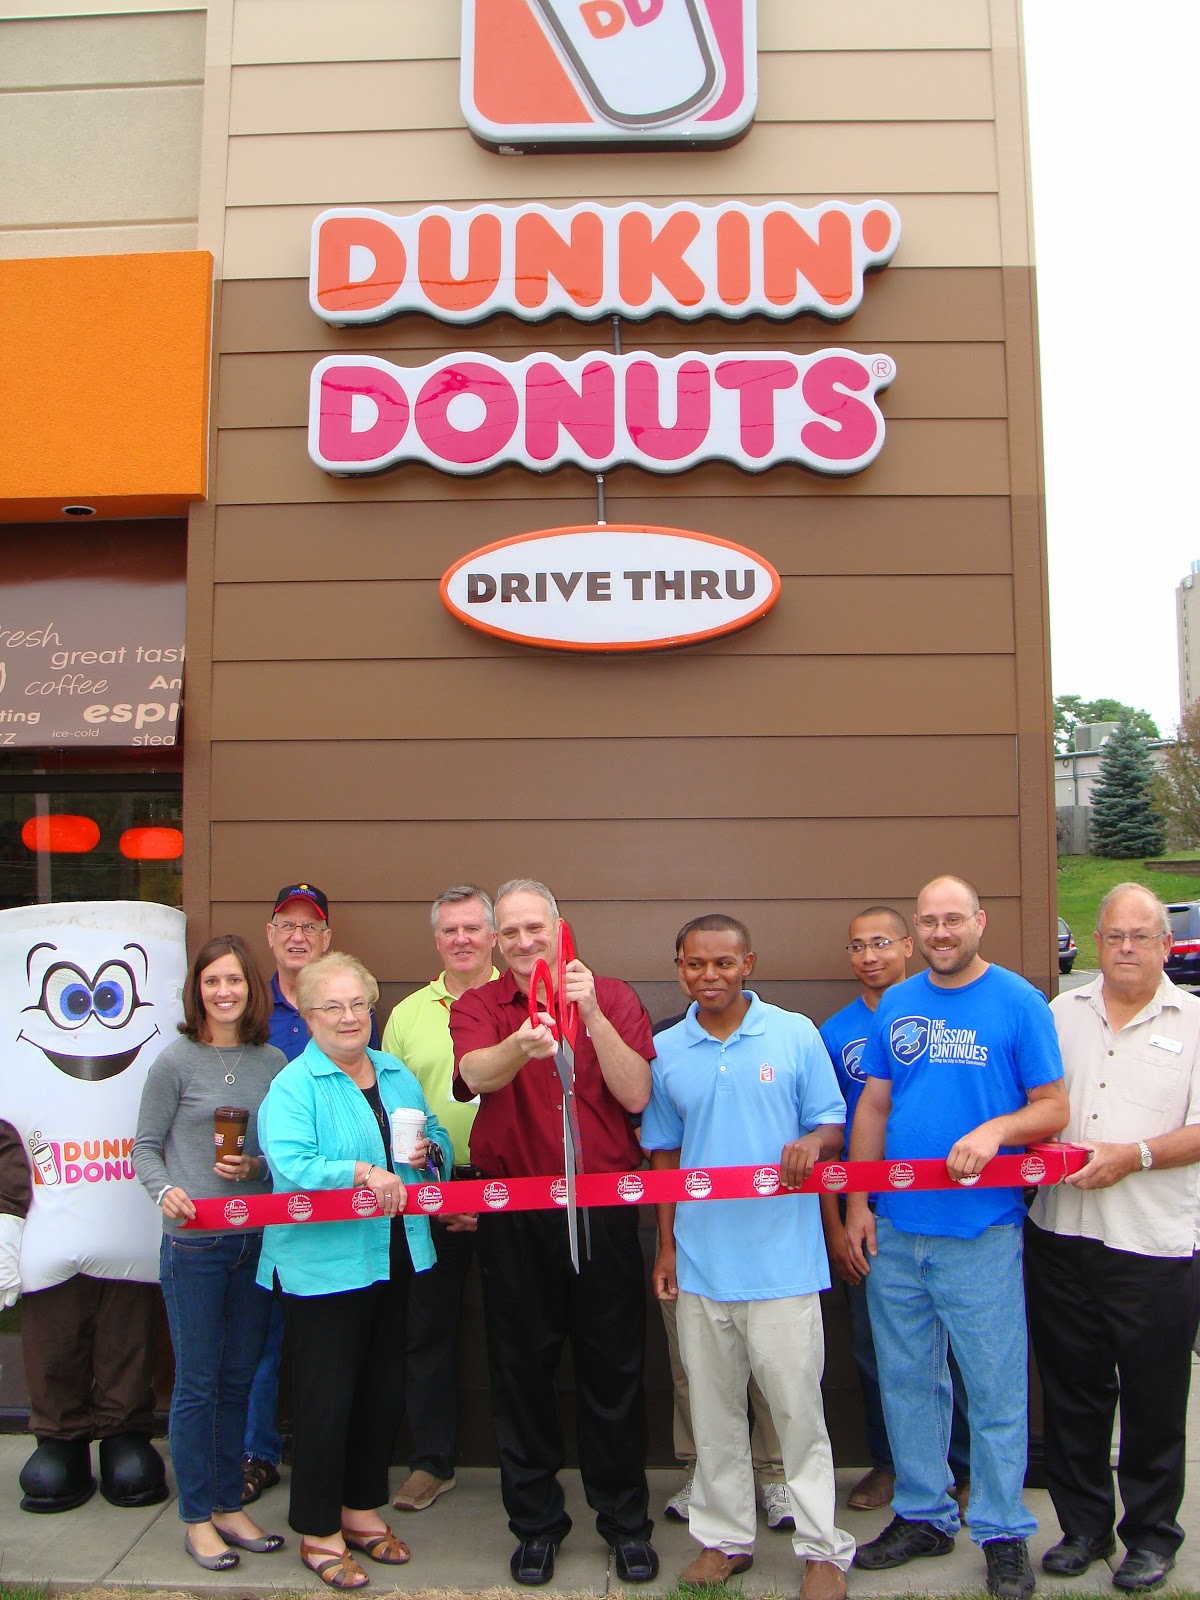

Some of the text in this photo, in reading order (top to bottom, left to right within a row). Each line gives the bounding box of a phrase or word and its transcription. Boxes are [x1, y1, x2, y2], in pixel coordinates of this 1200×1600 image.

[316, 208, 893, 313] DUNKIN'
[317, 356, 878, 464] DONUTS
[467, 569, 756, 603] DRIVE THRU
[0, 623, 63, 648] resh
[50, 646, 127, 670] great
[24, 673, 109, 695] coffee
[52, 728, 100, 738] ice-cold
[931, 1019, 947, 1030] THE
[930, 1028, 977, 1045] MISSION
[929, 1043, 989, 1062] CONTINUES
